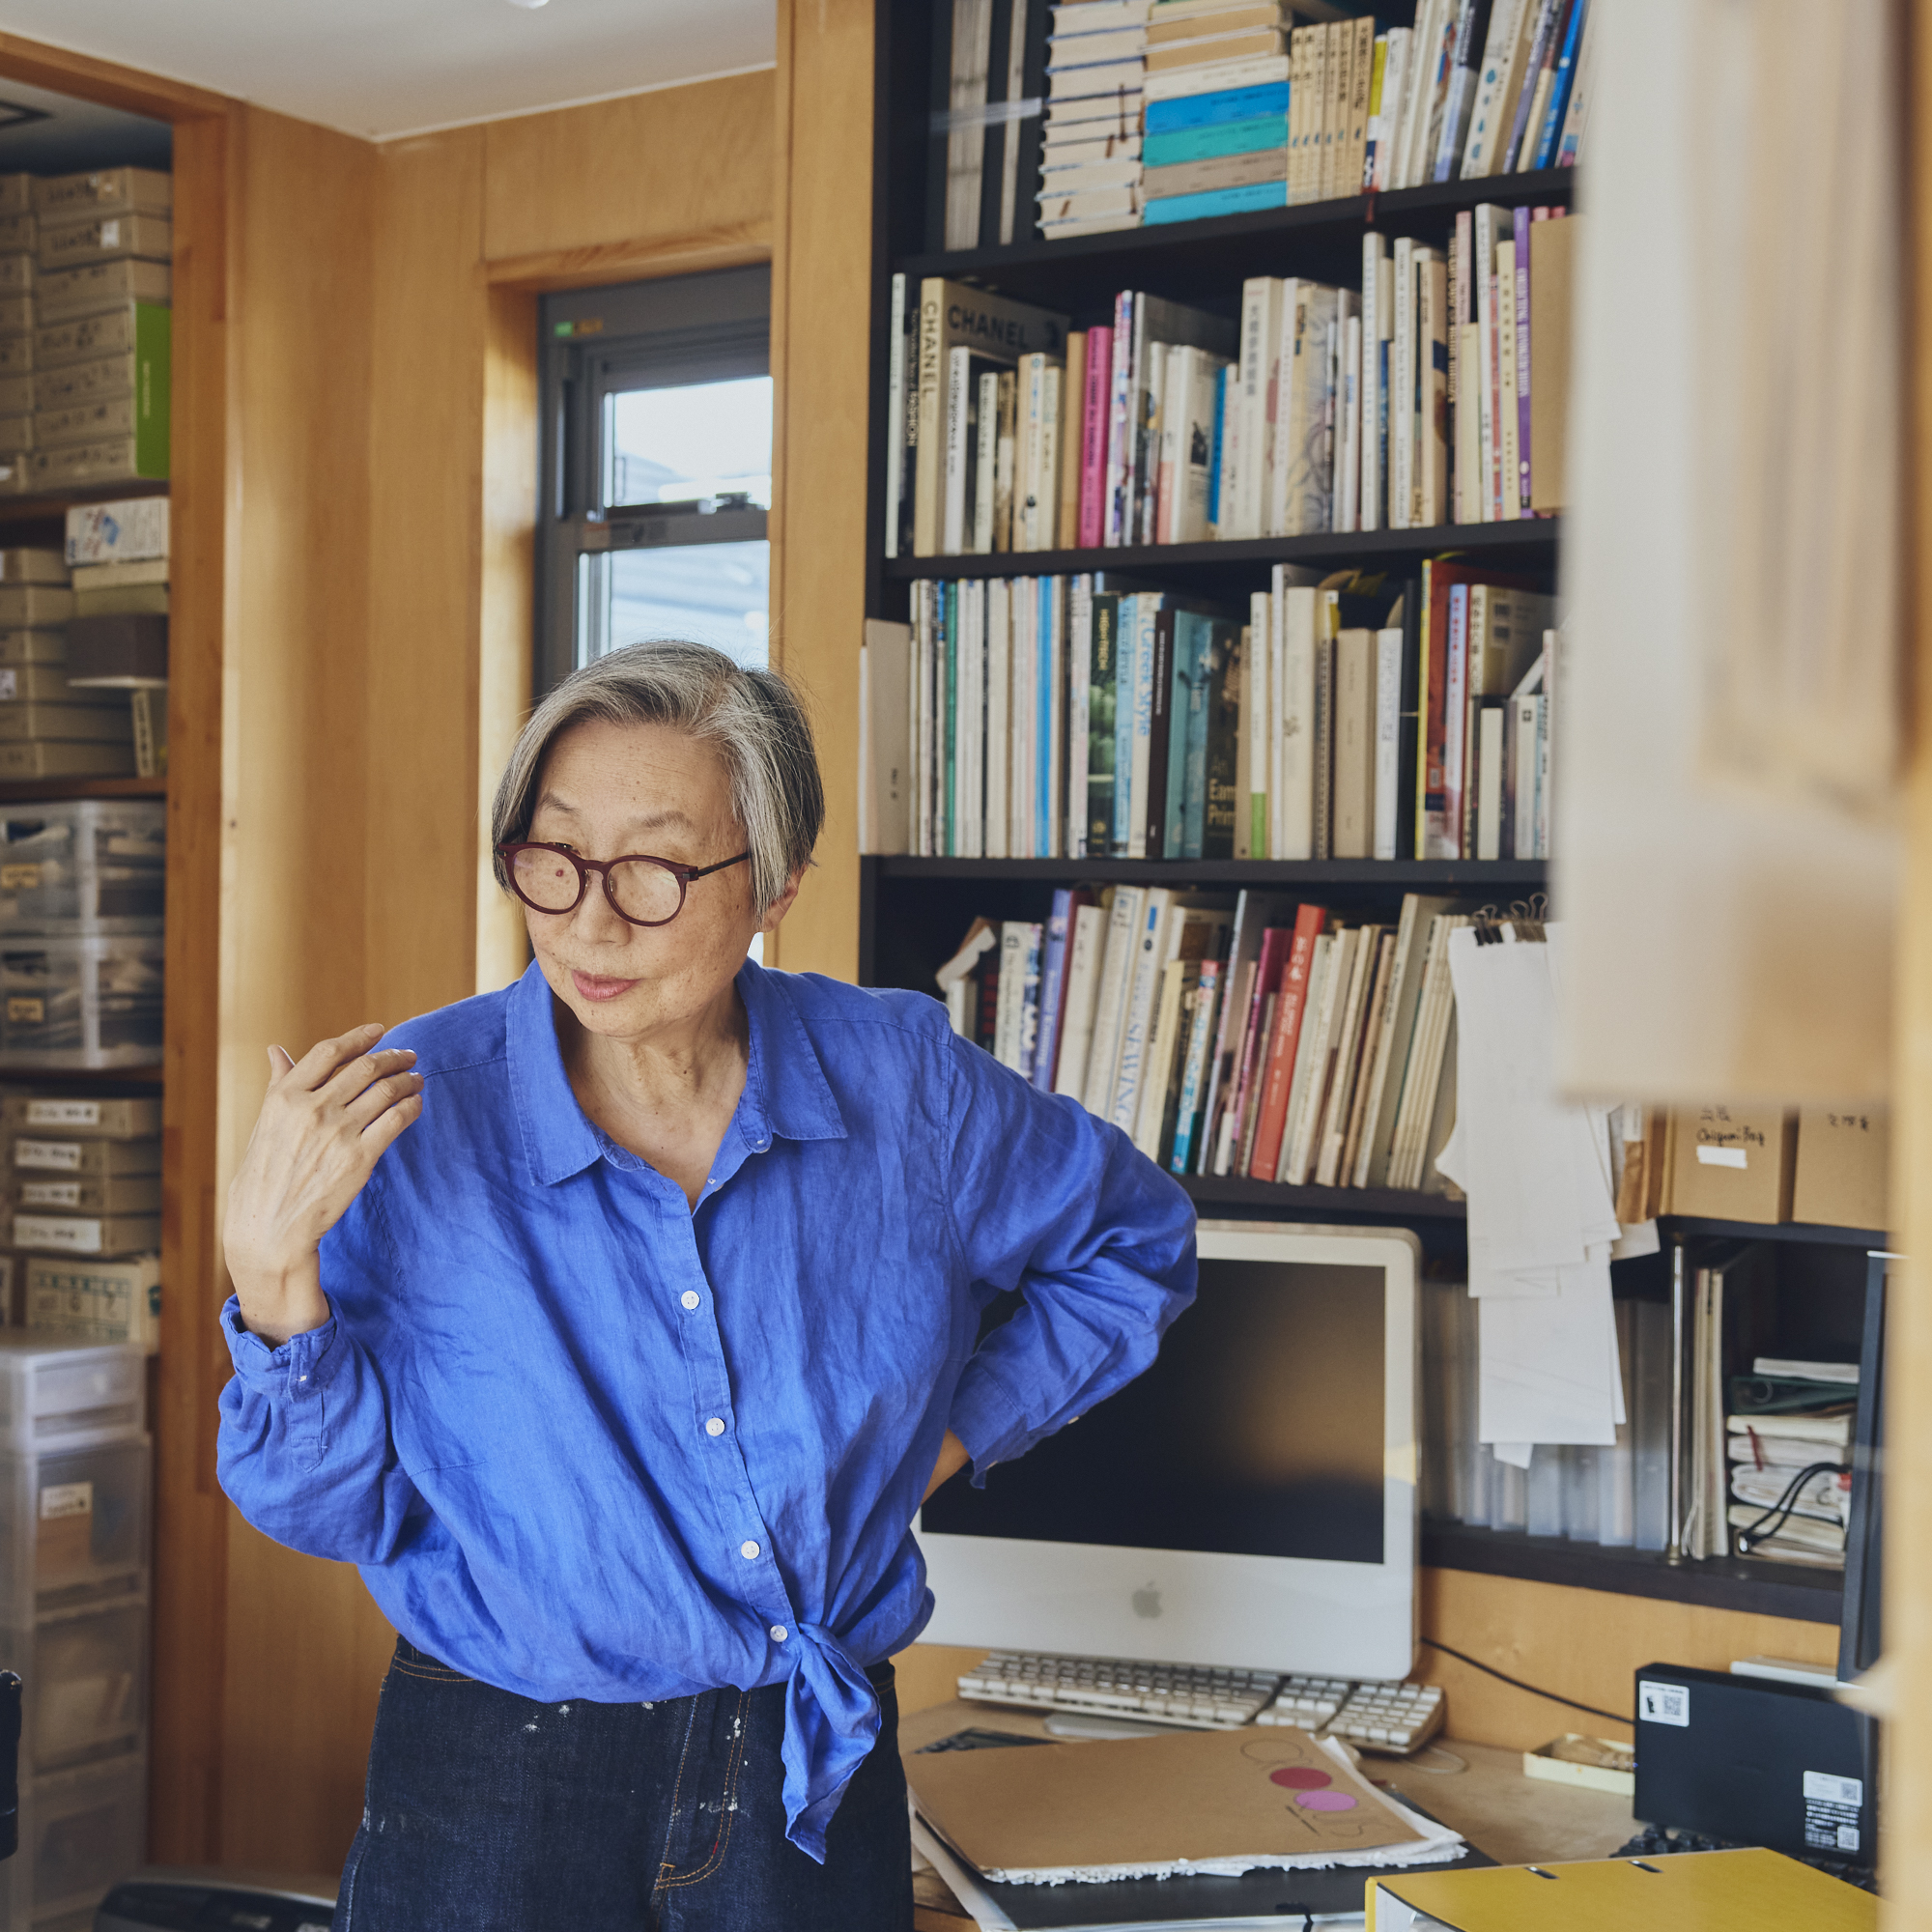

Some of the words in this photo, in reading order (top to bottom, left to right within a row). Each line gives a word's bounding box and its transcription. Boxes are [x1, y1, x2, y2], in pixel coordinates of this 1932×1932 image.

[922, 300, 938, 398] CHANEL
[948, 303, 1028, 350] CHANEL
[1134, 691, 1153, 736] Style
[1209, 778, 1237, 801] Eam
[1208, 804, 1236, 826] Prim
[1114, 1023, 1142, 1122] SEWING
